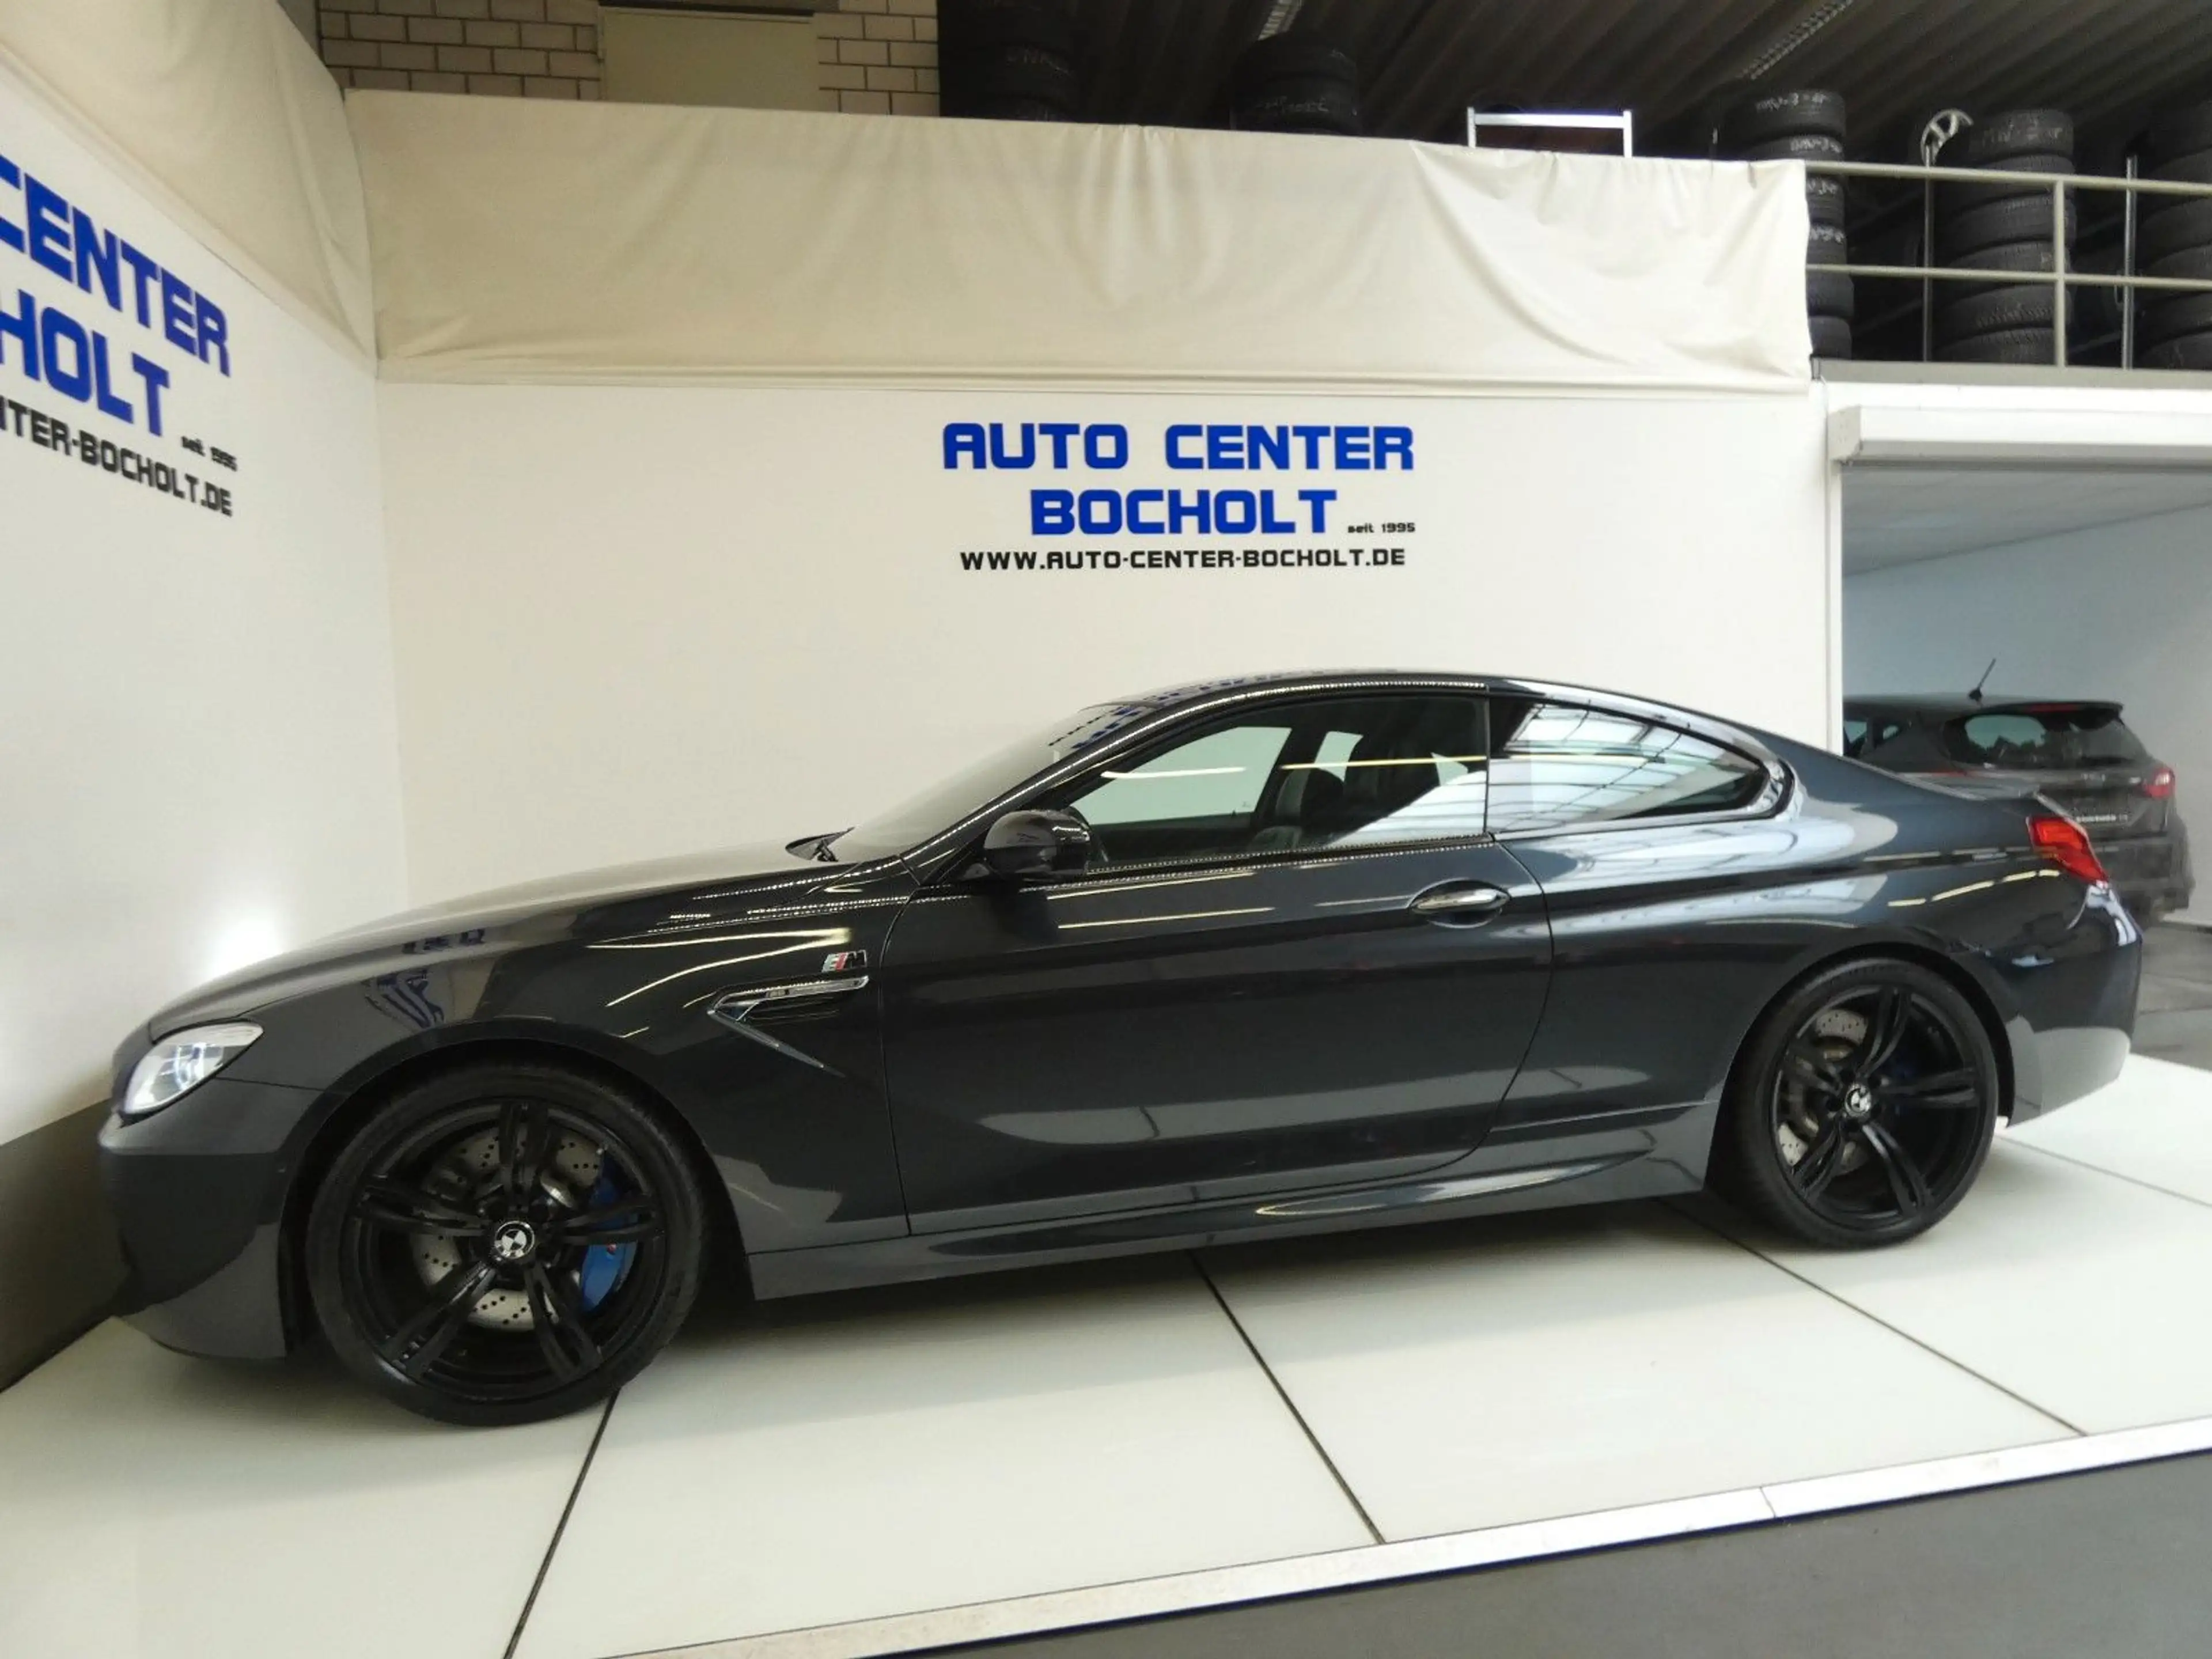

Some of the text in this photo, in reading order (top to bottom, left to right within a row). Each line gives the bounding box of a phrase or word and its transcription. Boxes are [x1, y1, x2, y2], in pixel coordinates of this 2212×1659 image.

[0, 395, 232, 517] TER-BOCHOLT.DE
[943, 423, 1414, 470] AUTO CENTER
[1031, 489, 1416, 535] BOCHOLT seit 1995
[960, 548, 1406, 570] WWW.AUTO-CENTER-BOCHOLT.DE
